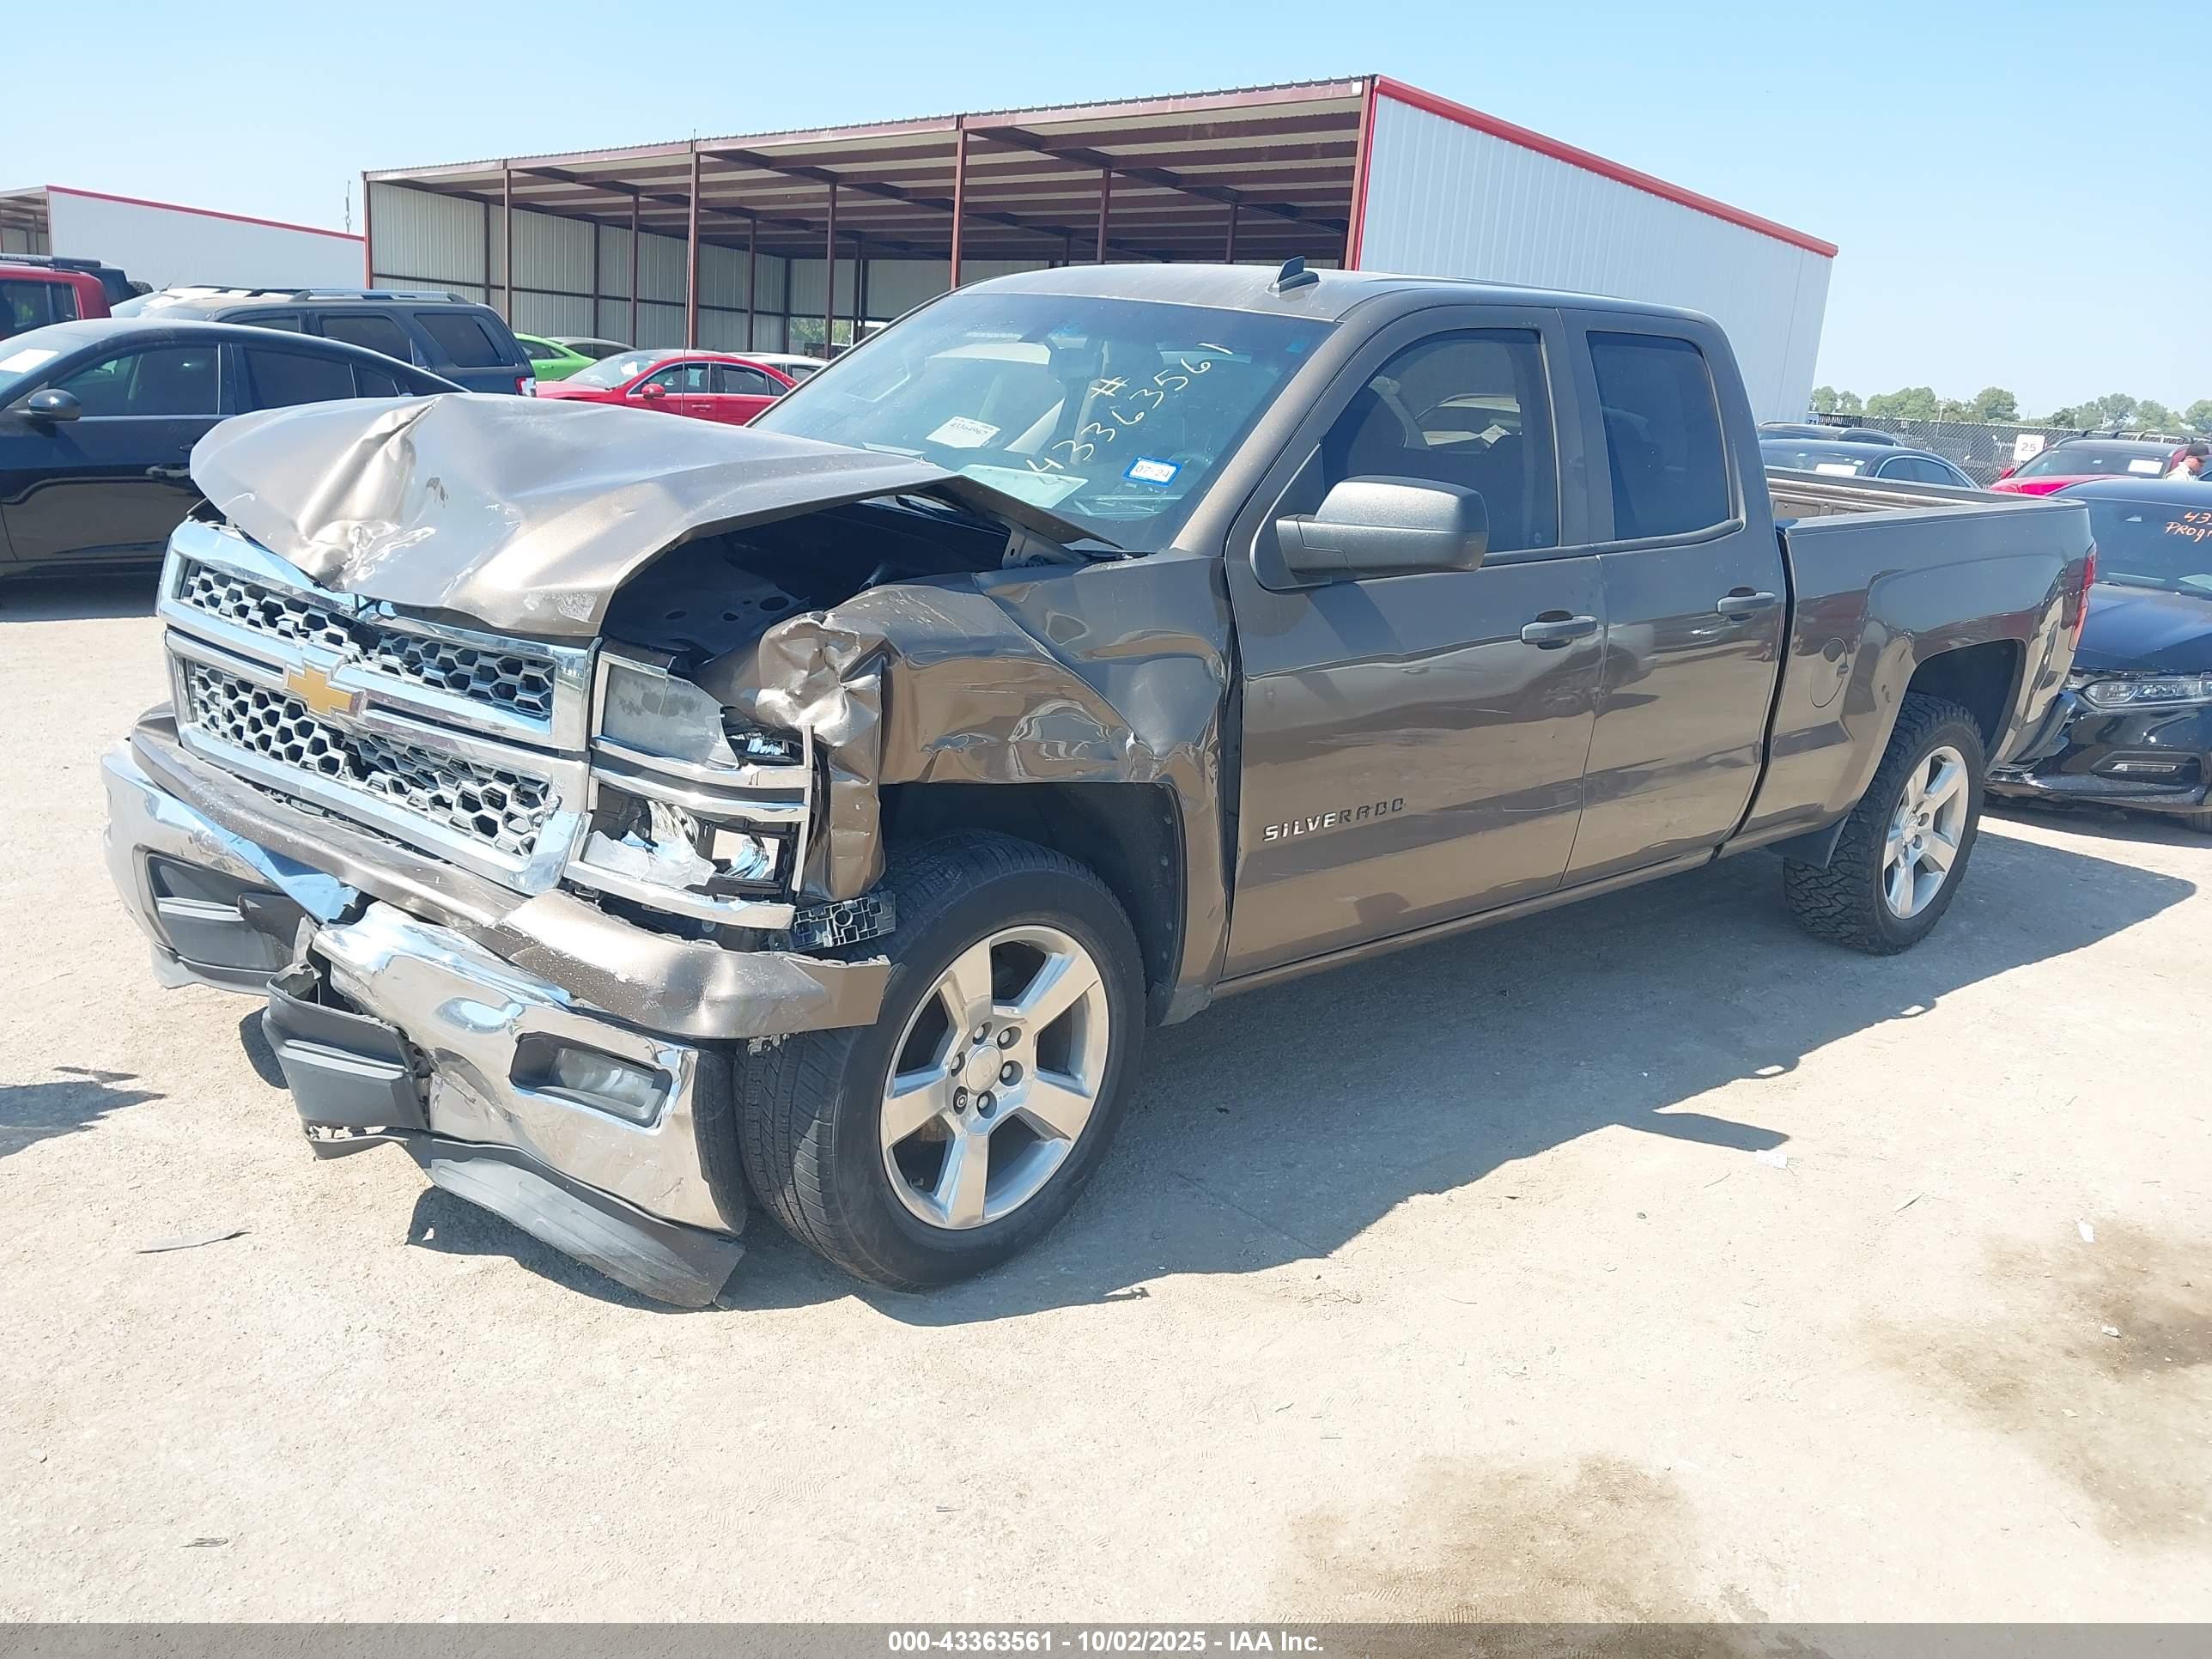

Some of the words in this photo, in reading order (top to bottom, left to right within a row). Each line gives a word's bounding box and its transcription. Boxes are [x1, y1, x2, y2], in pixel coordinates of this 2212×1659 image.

[1091, 376, 1131, 398] #
[1025, 342, 1234, 473] 43363561
[2021, 442, 2037, 452] 25
[2184, 511, 2212, 526] 43
[1262, 797, 1405, 842] SILVERADO
